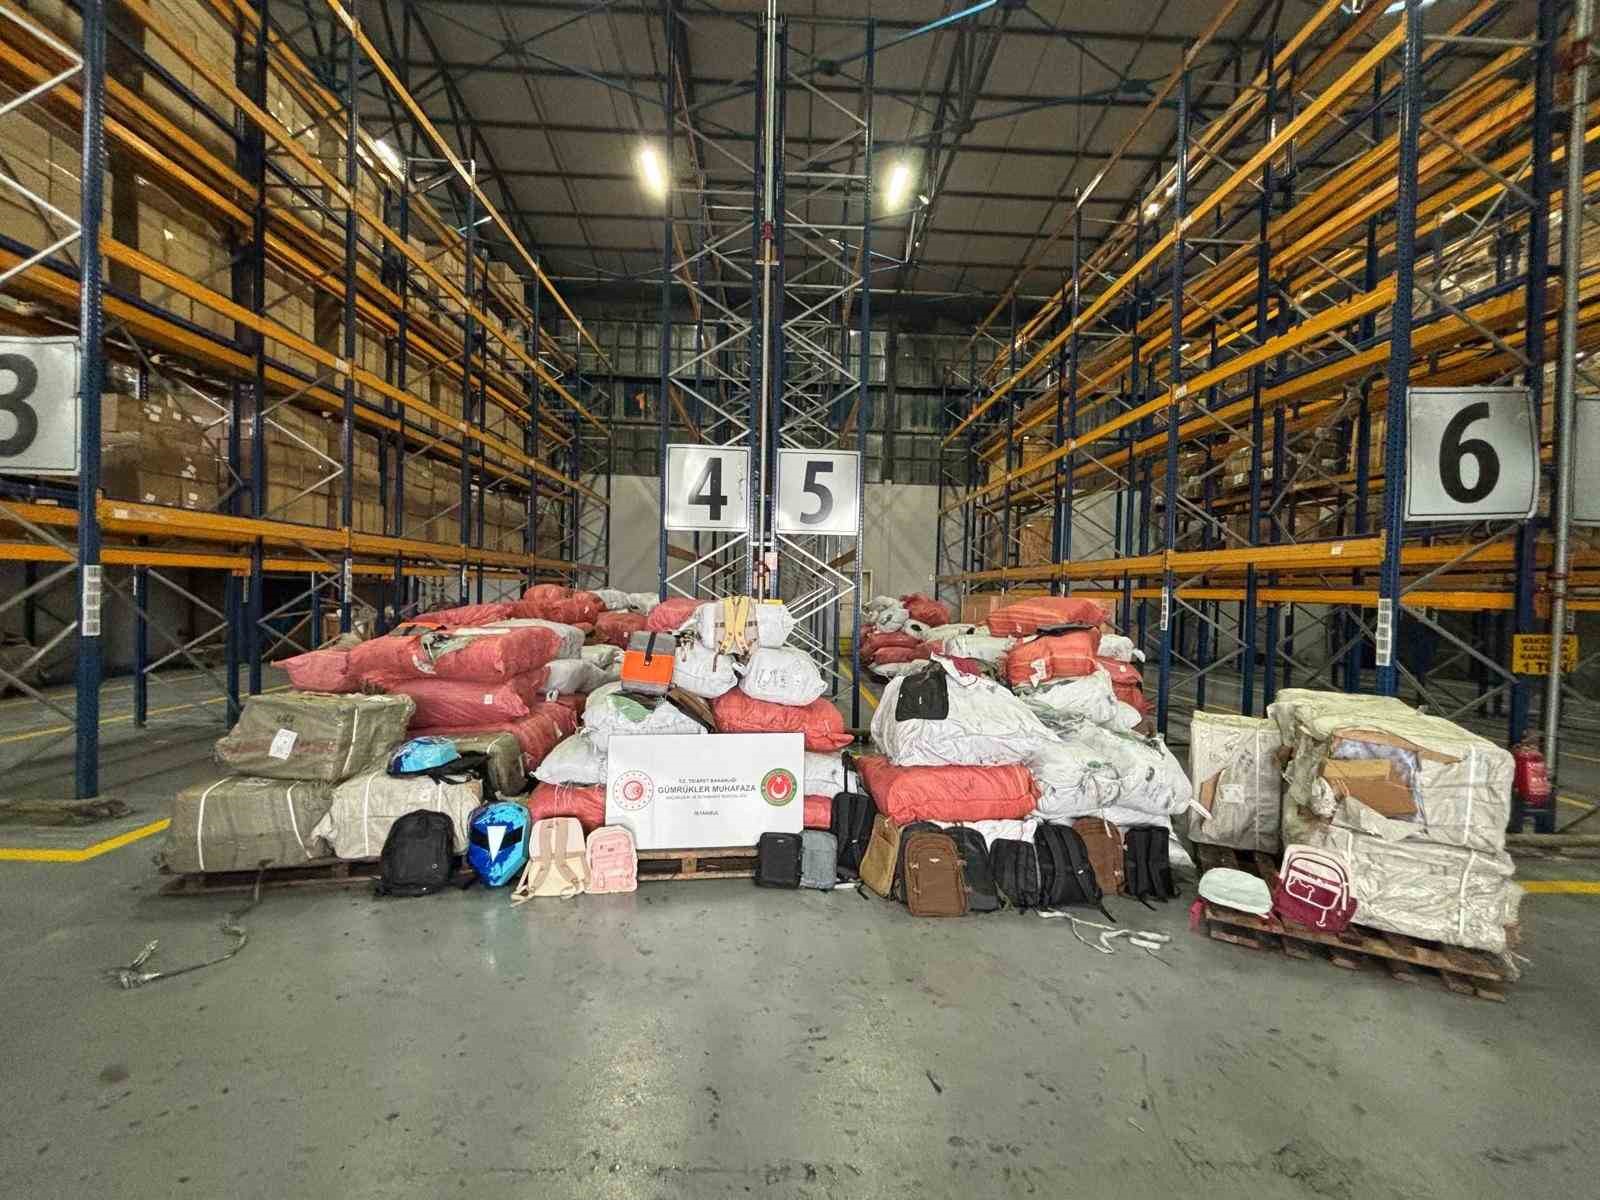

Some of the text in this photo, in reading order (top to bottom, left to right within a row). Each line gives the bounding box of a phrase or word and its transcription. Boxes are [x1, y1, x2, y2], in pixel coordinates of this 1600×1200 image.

[1439, 402, 1500, 503] 6
[688, 457, 728, 521] 4
[799, 461, 834, 525] 5
[1523, 662, 1529, 673] 1
[658, 785, 756, 794] GÜMRÜKLER MUHAFAZA
